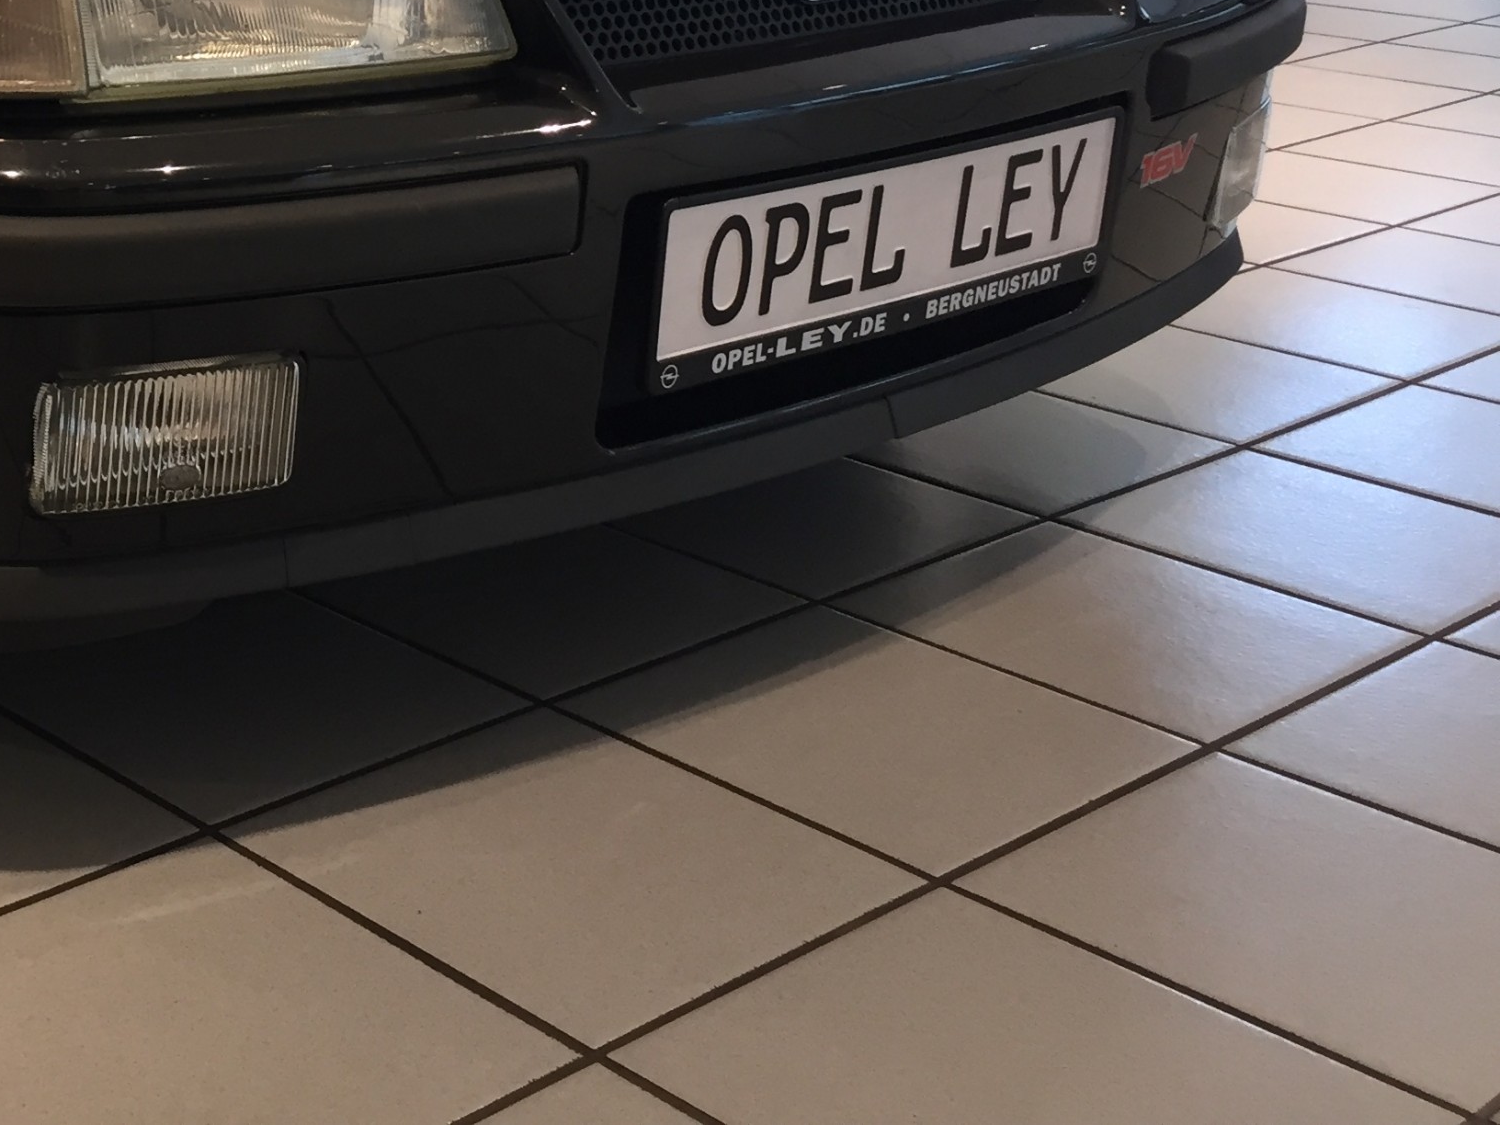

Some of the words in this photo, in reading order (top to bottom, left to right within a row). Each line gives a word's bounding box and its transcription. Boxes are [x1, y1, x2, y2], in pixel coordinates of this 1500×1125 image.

[1140, 132, 1198, 188] 16V
[701, 184, 906, 327] OPEL
[950, 138, 1088, 268] LEY
[711, 312, 888, 374] OPEL-LEY.DE
[925, 263, 1062, 319] BERGNEUSTADT
